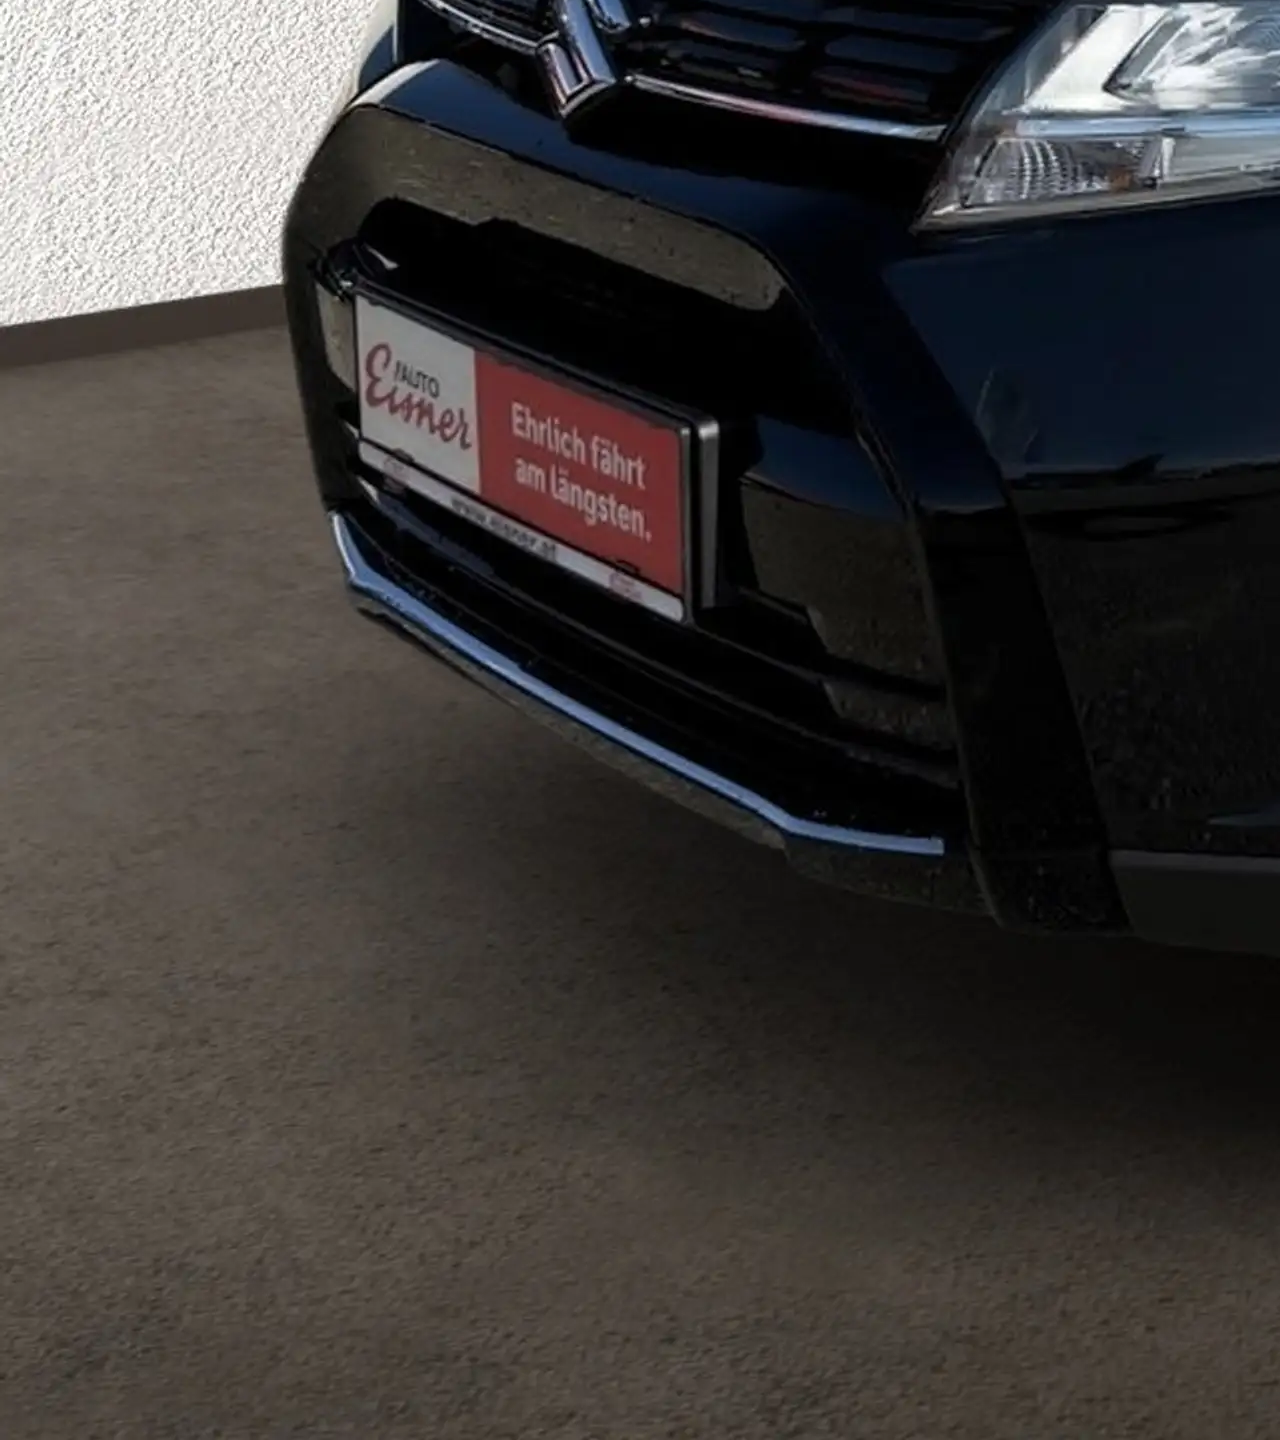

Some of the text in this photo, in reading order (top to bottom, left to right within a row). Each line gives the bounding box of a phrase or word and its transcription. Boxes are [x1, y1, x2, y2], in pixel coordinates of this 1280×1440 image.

[365, 342, 472, 450] Eisner
[401, 363, 440, 399] AUTO
[511, 401, 647, 490] Ehrlich fährt
[515, 457, 653, 544] am längsten.
